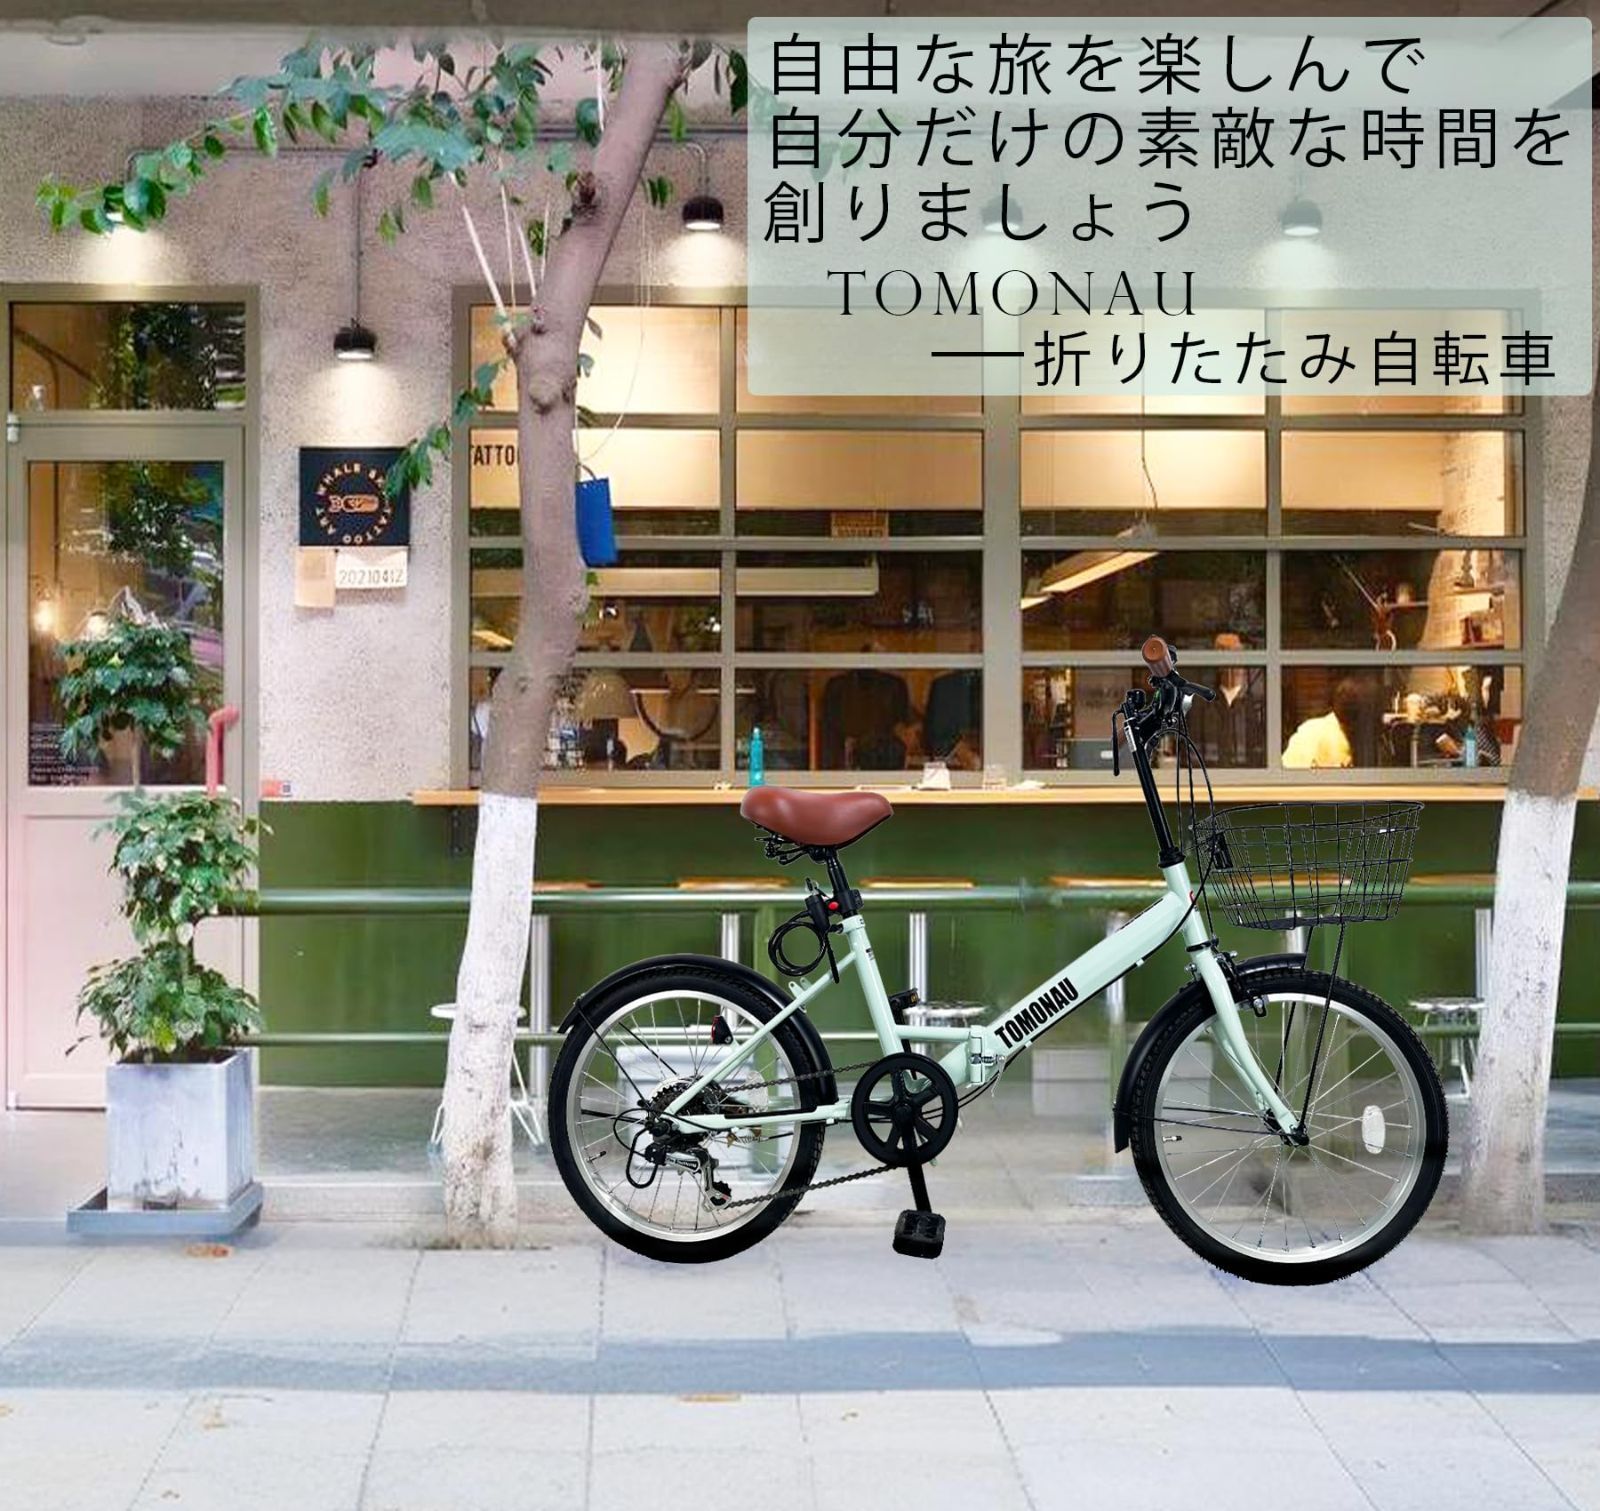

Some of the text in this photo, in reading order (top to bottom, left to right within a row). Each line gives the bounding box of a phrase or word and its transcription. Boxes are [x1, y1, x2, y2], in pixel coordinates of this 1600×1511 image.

[469, 444, 519, 466] TATTO
[316, 463, 361, 495] WHALE
[316, 506, 337, 535] ART
[342, 507, 392, 544] TATTOO
[994, 976, 1079, 1049] TOMONAU
